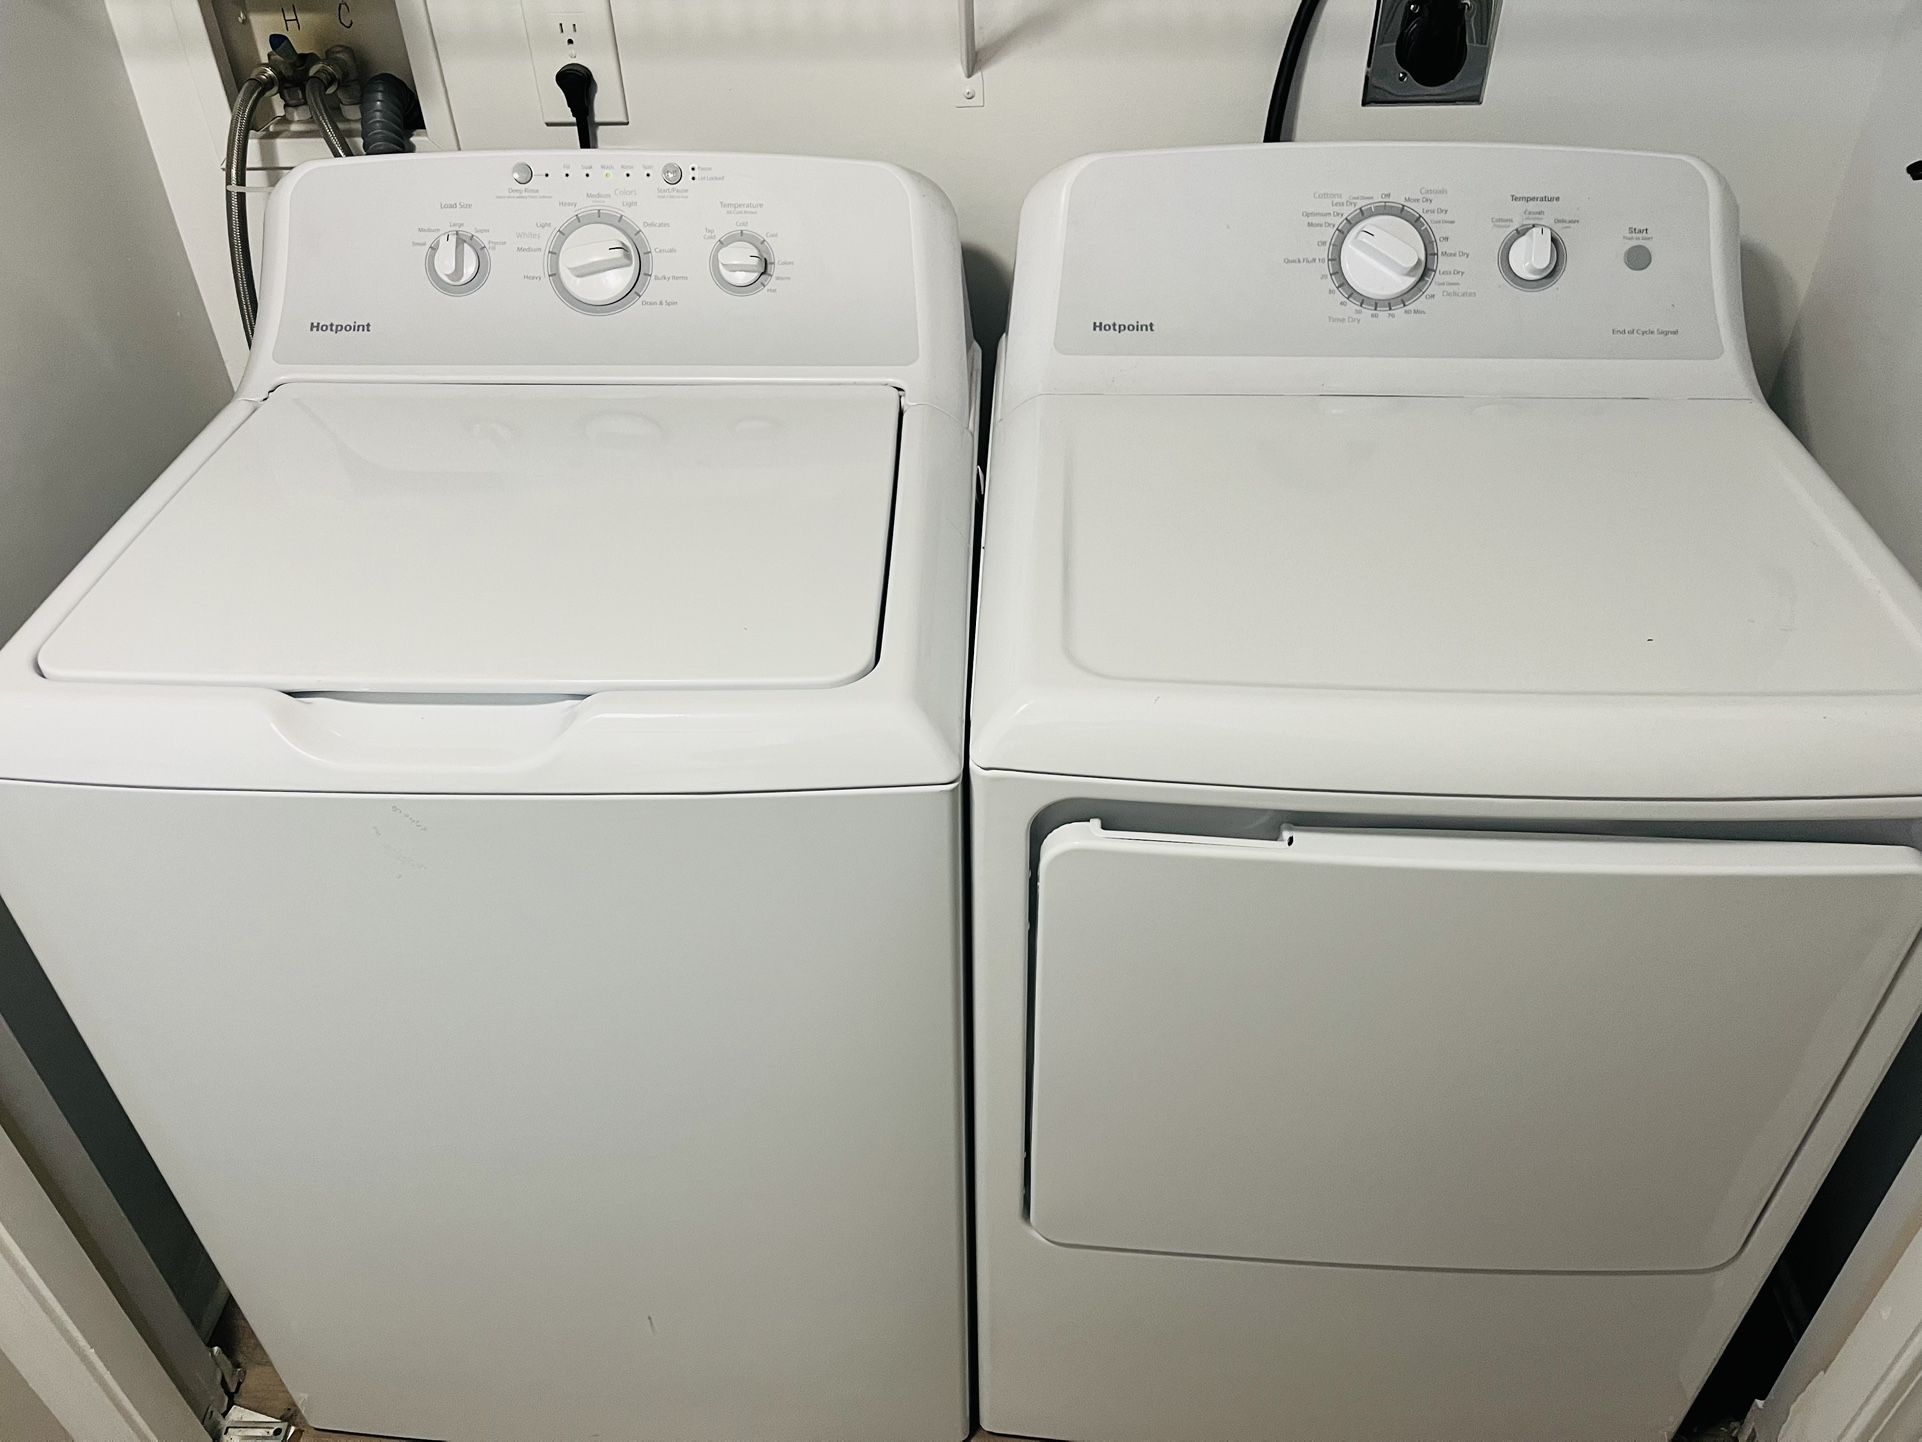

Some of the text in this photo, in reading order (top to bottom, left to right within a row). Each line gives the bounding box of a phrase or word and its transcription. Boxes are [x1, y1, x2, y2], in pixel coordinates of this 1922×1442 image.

[281, 2, 353, 31] H C
[508, 187, 523, 195] Deep
[614, 188, 637, 196] Colors
[1420, 187, 1447, 195] Casuals
[1510, 194, 1560, 203] Temperature
[622, 200, 638, 208] Light
[720, 201, 764, 210] Temperature
[1346, 200, 1357, 208] Dry
[516, 231, 541, 239] Whites
[1628, 227, 1648, 235] Start
[653, 274, 671, 282] Bulky
[1347, 316, 1361, 324] Dry
[310, 321, 371, 334] Hotpoint
[1093, 321, 1154, 334] Hotpoint
[1636, 328, 1655, 336] Cycle
[1656, 328, 1679, 336] Signal
